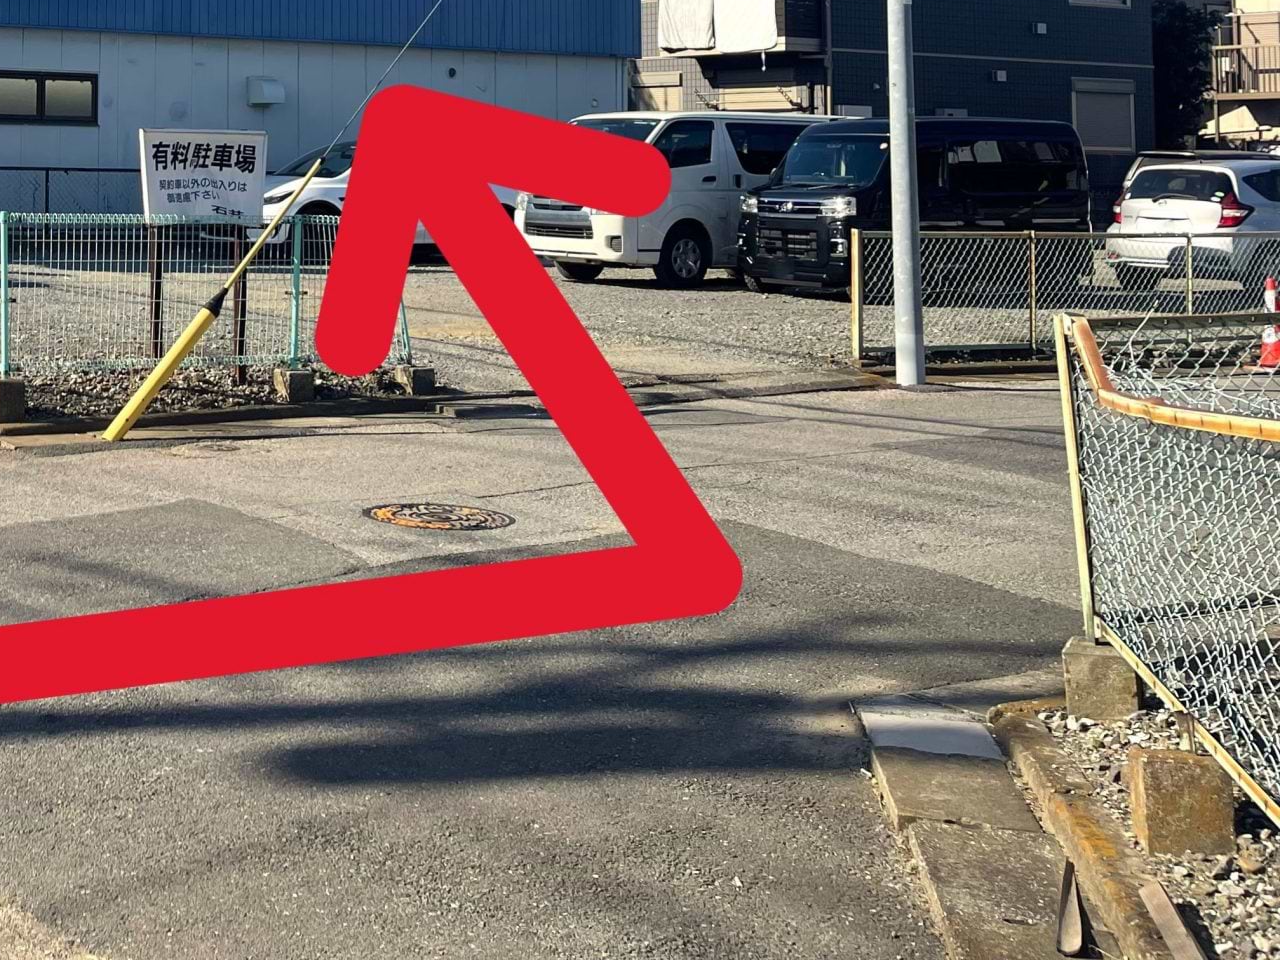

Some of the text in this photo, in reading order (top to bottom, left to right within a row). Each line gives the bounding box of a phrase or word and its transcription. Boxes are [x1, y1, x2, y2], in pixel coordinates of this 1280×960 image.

[152, 141, 256, 173] 有料駐車場
[159, 177, 247, 192] 契約車以外の出入りは
